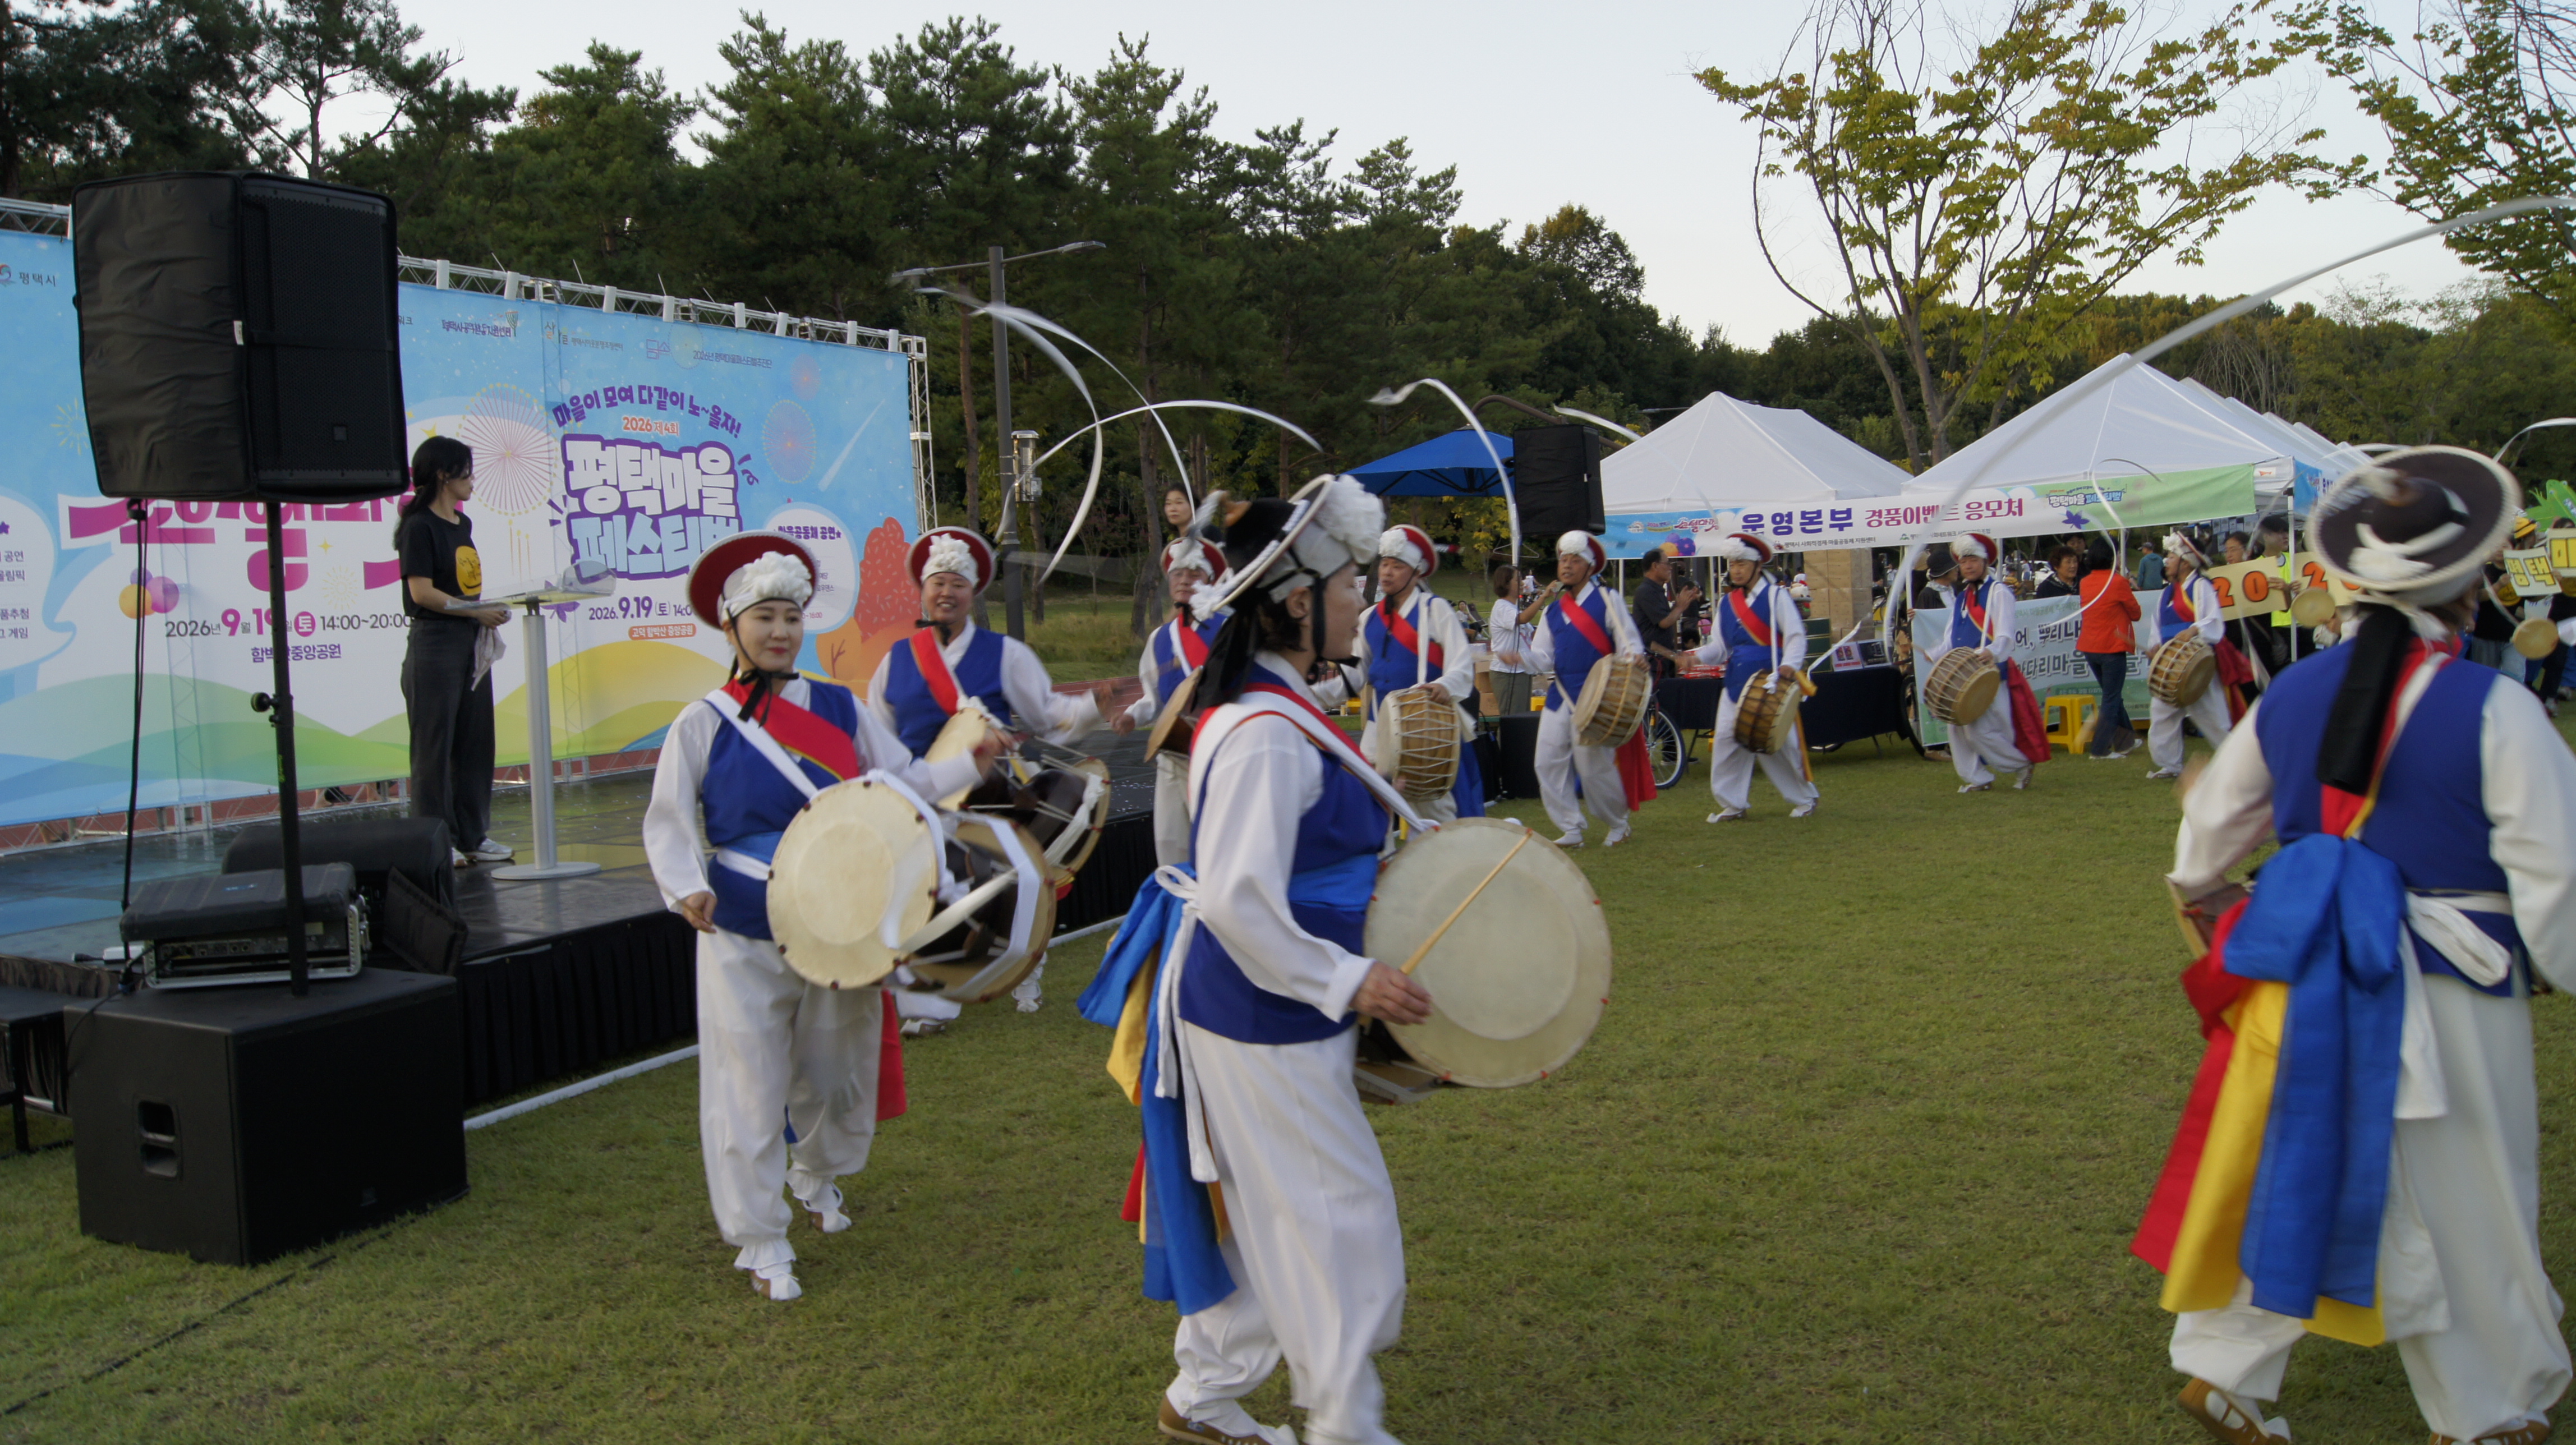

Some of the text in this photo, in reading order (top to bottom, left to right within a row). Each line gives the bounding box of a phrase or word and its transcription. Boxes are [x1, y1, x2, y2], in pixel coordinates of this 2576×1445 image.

[19, 271, 56, 287] 평택시
[552, 384, 742, 439] 마을이 모여 다같이 노~올자!
[622, 416, 679, 436] 2026 제4회
[564, 440, 736, 518] 평택마을
[1965, 498, 2023, 521] 응모처
[820, 526, 836, 540] 공연
[4, 550, 24, 562] 공연
[2505, 555, 2556, 586] 평택
[2212, 570, 2269, 608] 20
[588, 606, 619, 620] 2026.
[618, 596, 653, 619] 9.19
[8, 627, 28, 639] 게임
[668, 625, 693, 637] 중앙공원
[251, 643, 342, 663] 함중앙공원
